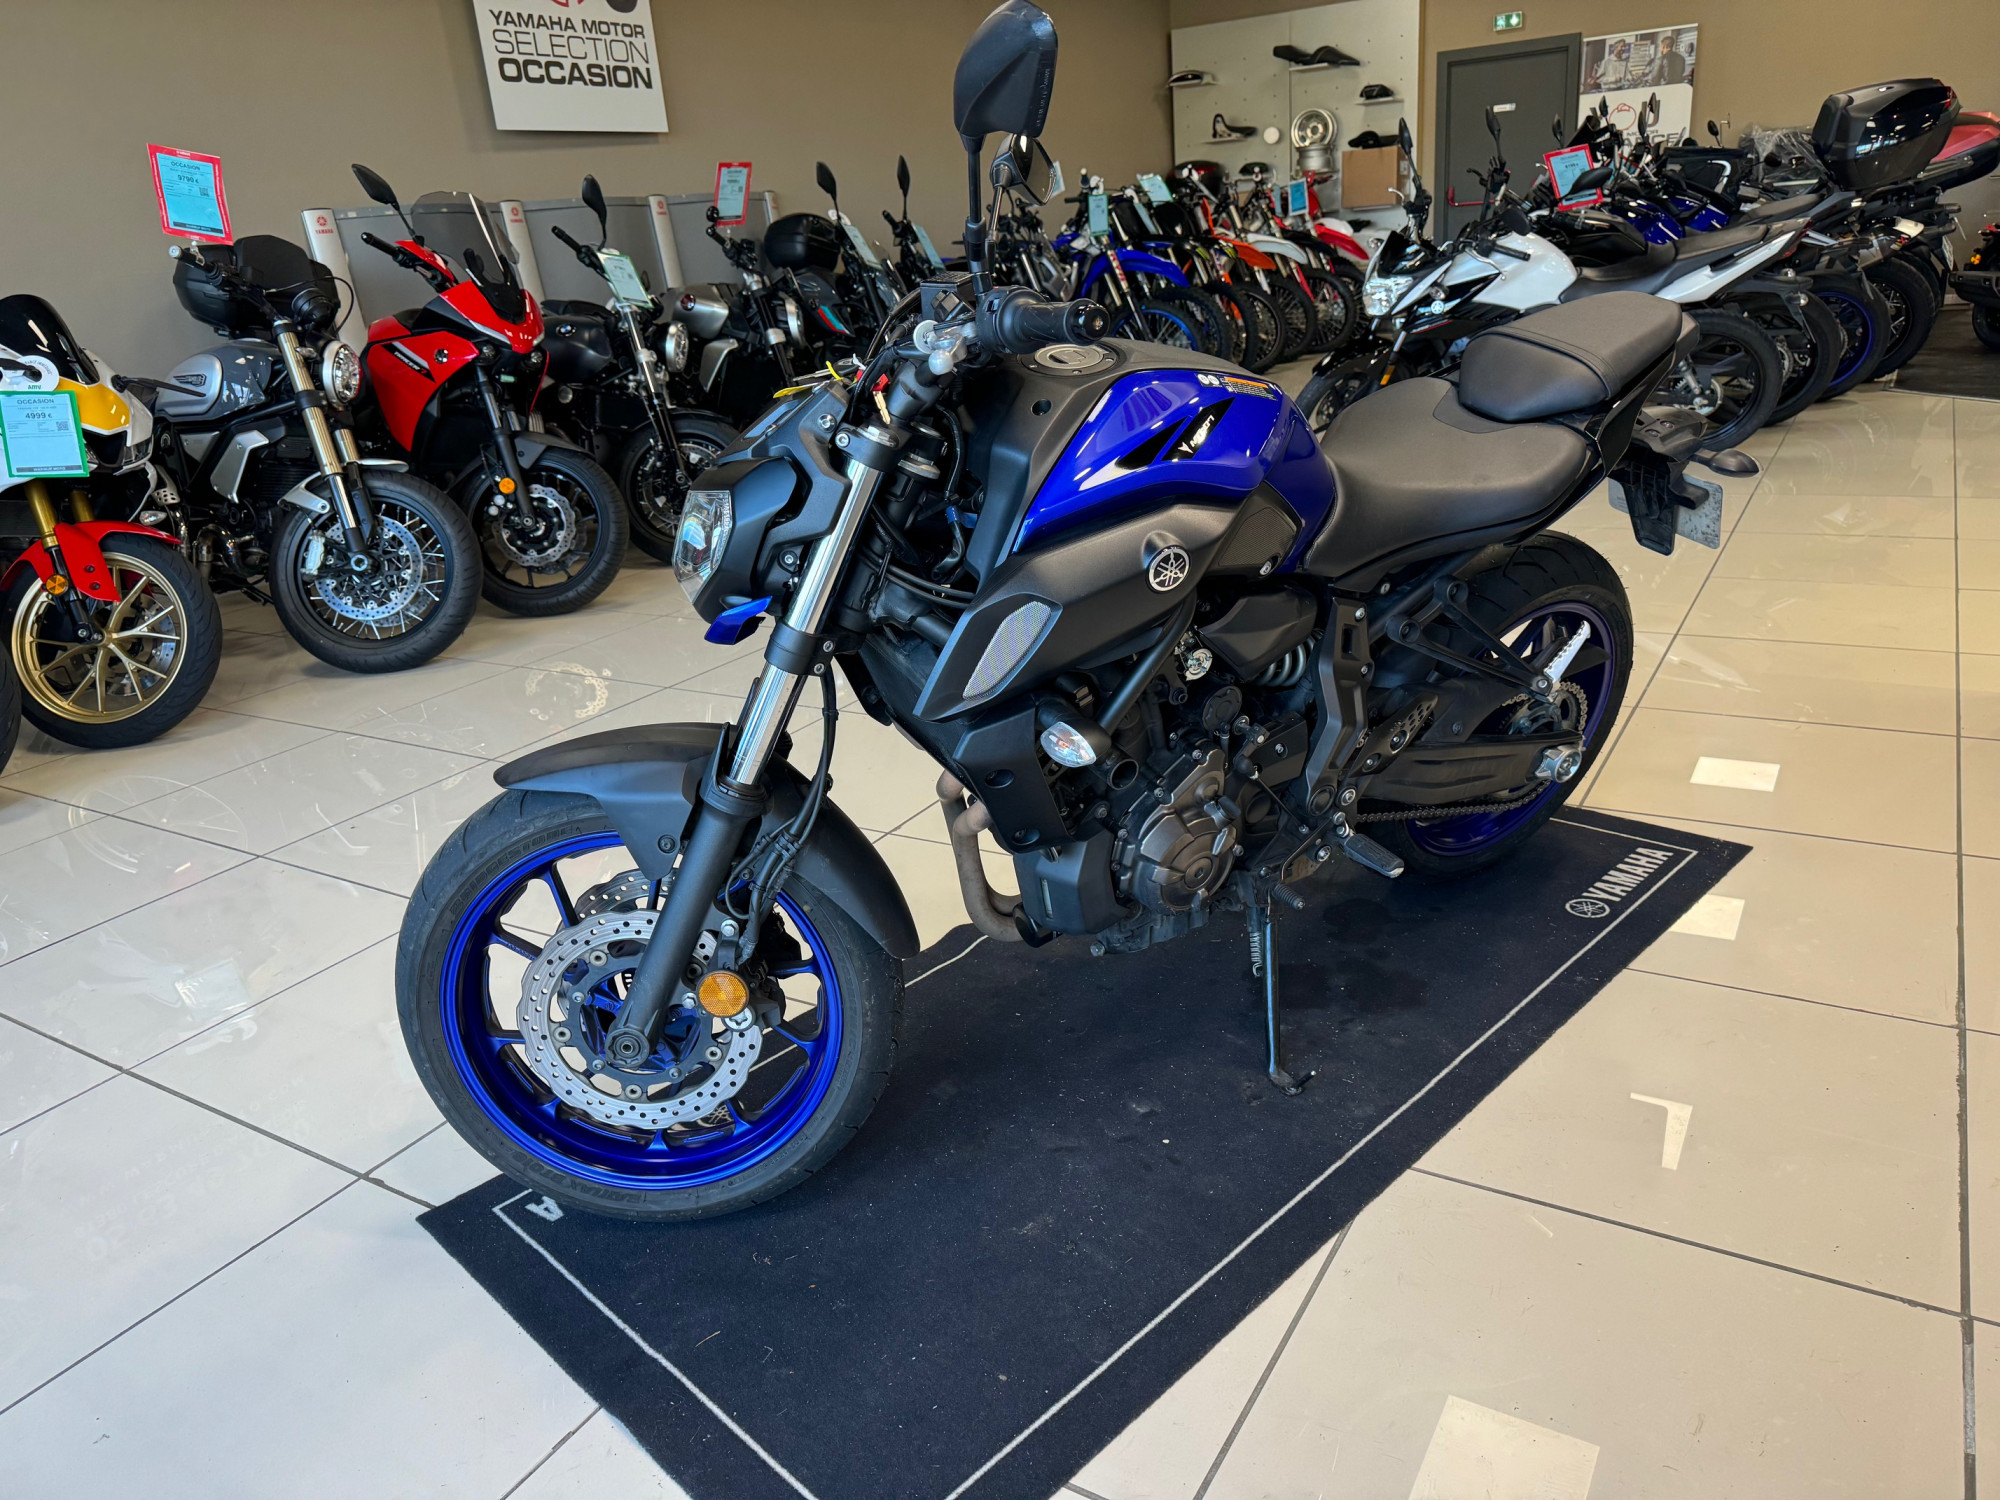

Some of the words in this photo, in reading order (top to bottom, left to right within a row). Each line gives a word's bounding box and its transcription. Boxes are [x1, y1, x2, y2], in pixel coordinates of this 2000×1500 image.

[489, 9, 577, 33] YAMAHA
[582, 19, 645, 39] MOTOR
[492, 29, 649, 64] SELECTION
[498, 57, 653, 89] OCCASION
[170, 161, 201, 171] OCCASION
[1581, 847, 1674, 902] YAMAHA
